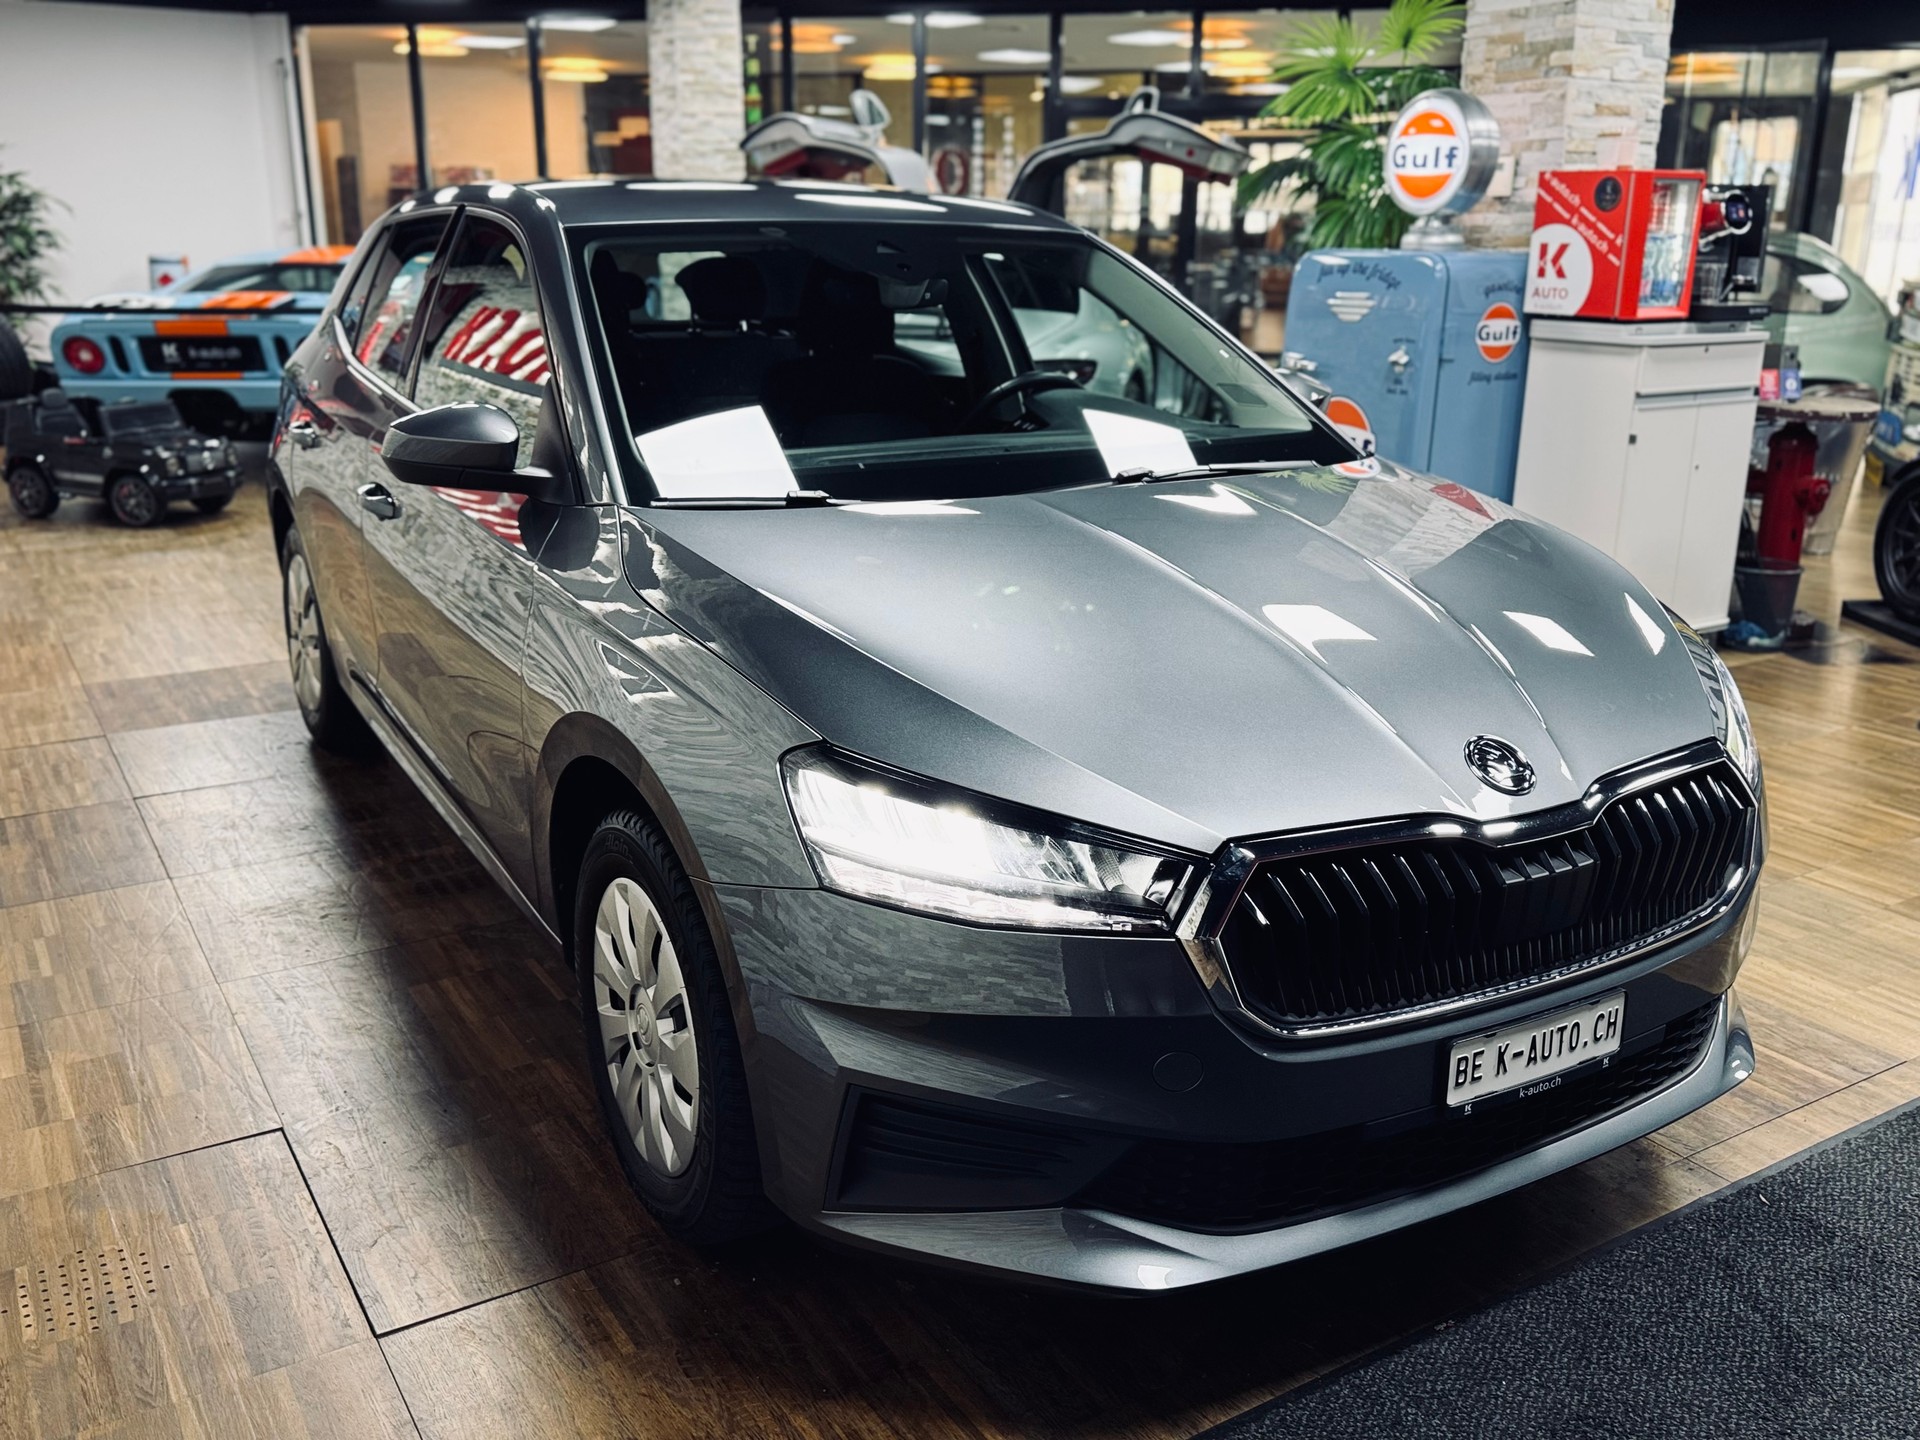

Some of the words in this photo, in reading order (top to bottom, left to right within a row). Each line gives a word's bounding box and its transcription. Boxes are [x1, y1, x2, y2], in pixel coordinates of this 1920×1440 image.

[1393, 144, 1459, 168] Gulf
[1537, 243, 1570, 279] K
[1532, 287, 1569, 300] AUTO
[1478, 325, 1520, 341] Gulf
[1454, 1048, 1486, 1088] BE
[1495, 1006, 1620, 1077] K-AUTO.CH
[1519, 1075, 1562, 1099] k-auto.ch
